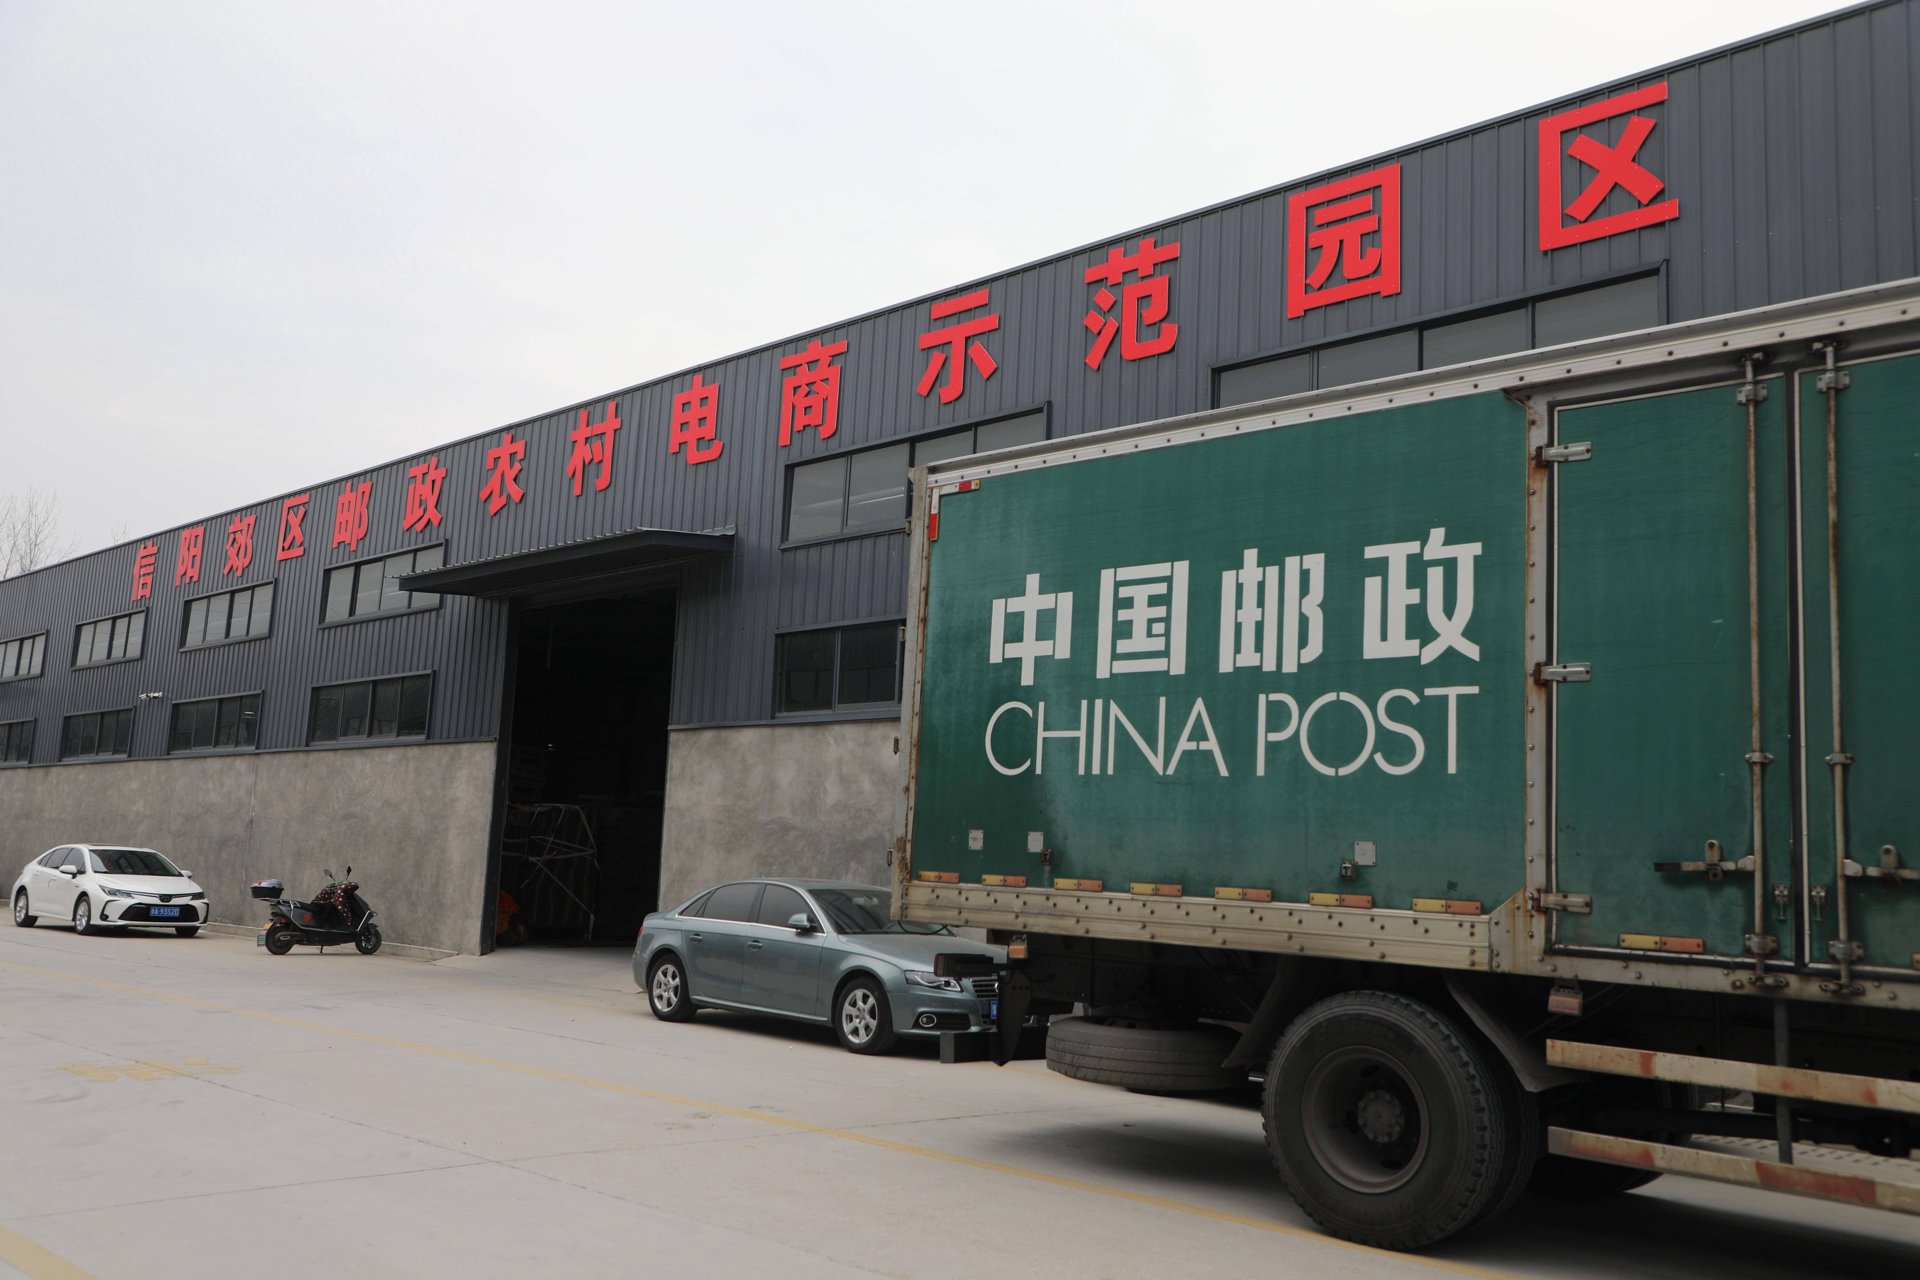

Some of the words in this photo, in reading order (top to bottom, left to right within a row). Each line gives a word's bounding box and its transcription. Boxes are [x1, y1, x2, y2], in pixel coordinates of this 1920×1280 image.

[131, 81, 1680, 600] 信阳郊区邮政农村电商示范园区
[988, 527, 1483, 686] 中国邮政
[984, 696, 1230, 777] CHINA
[1256, 685, 1480, 777] POST
